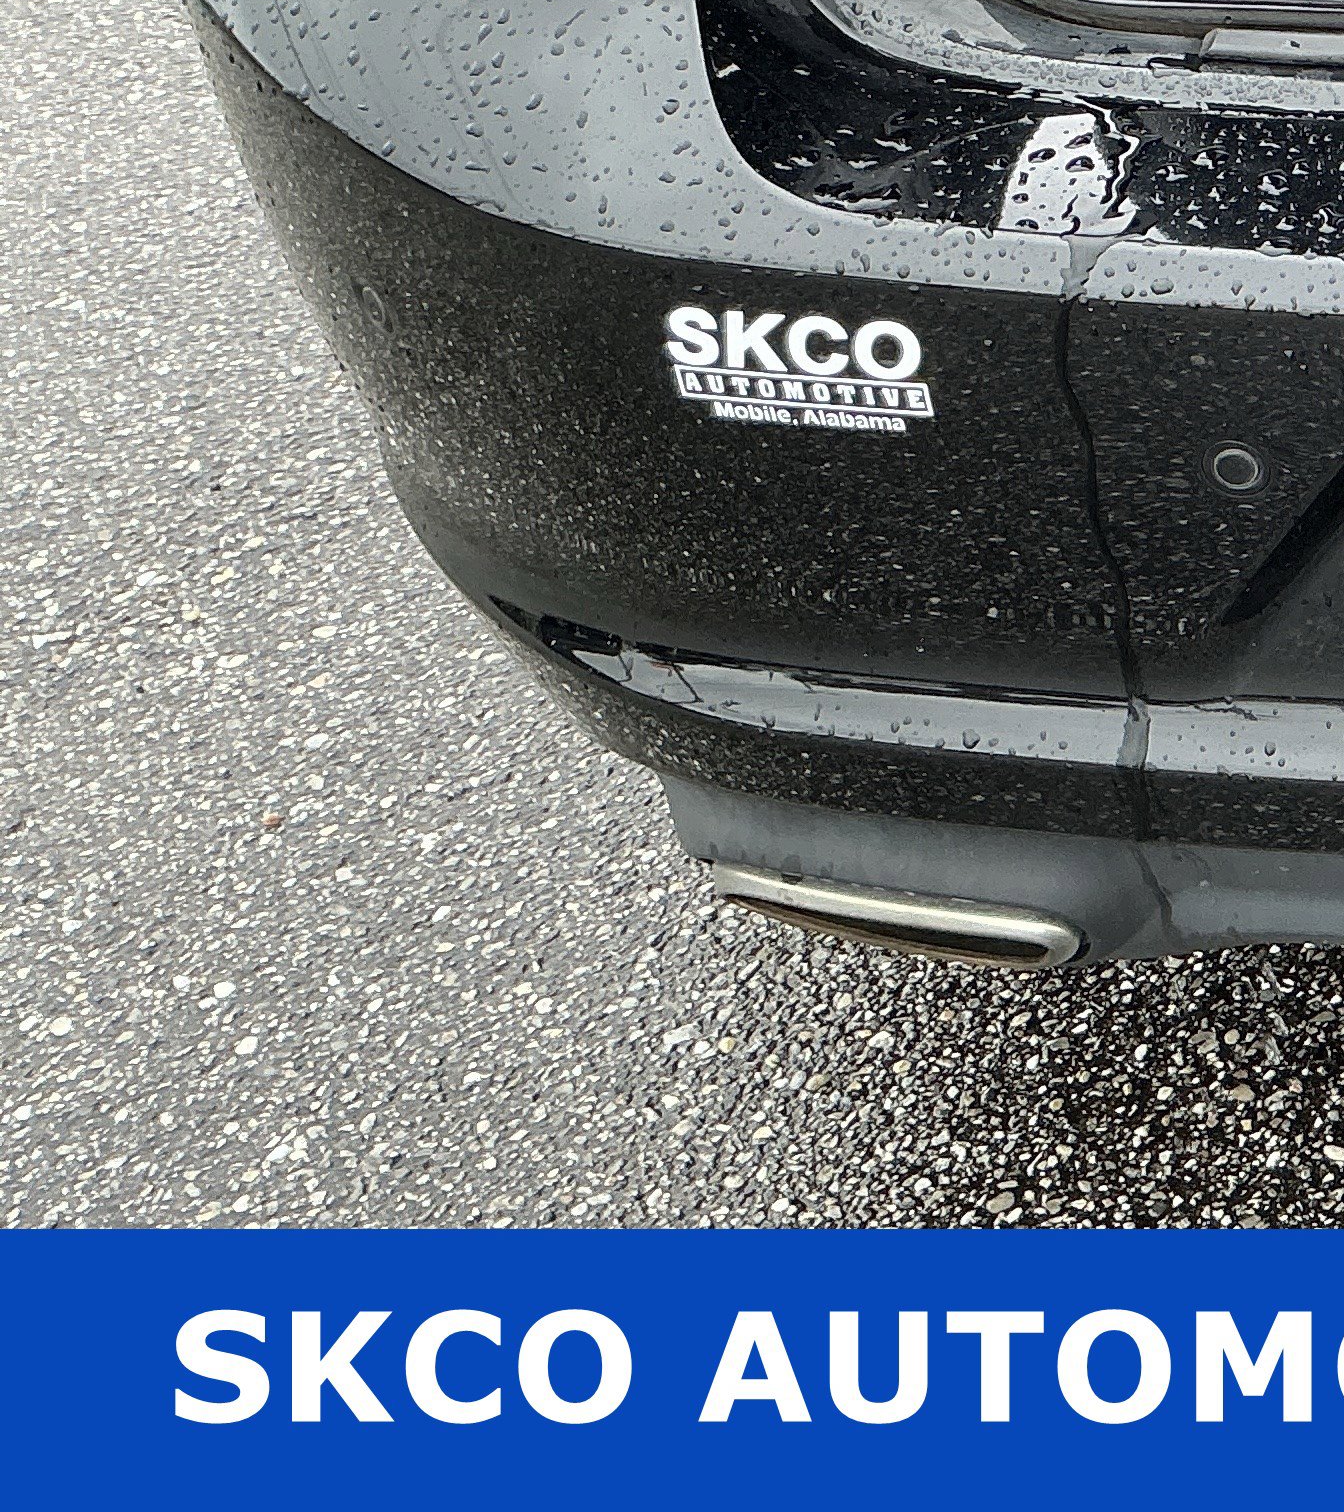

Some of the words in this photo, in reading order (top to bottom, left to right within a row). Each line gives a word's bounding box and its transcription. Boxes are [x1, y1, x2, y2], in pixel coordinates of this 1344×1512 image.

[666, 306, 922, 381] SKCO
[685, 372, 927, 409] AUTOMOTIVE
[712, 401, 799, 426] Mobile,
[803, 410, 906, 431] Alabama
